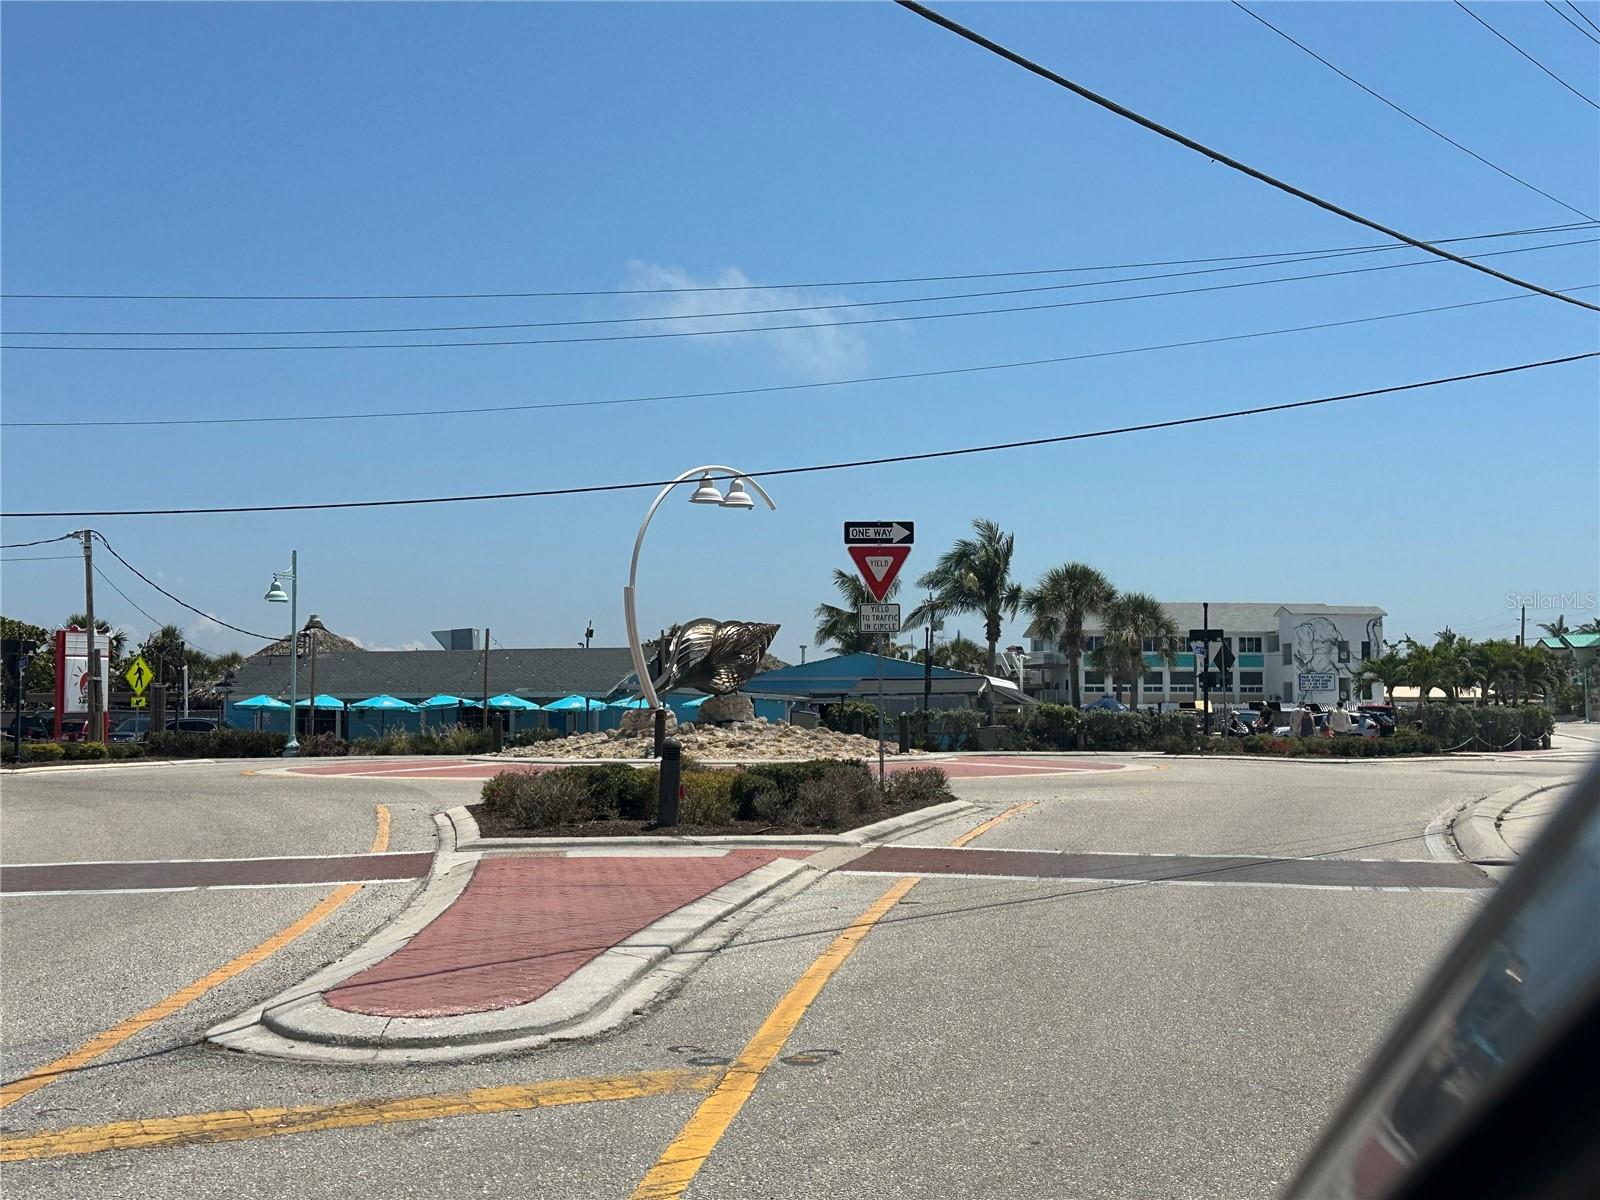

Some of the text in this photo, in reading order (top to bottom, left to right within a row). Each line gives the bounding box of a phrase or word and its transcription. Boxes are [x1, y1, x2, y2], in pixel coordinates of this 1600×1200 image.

[851, 529, 893, 538] ONE WAY
[862, 614, 898, 622] TO TRAFFIC
